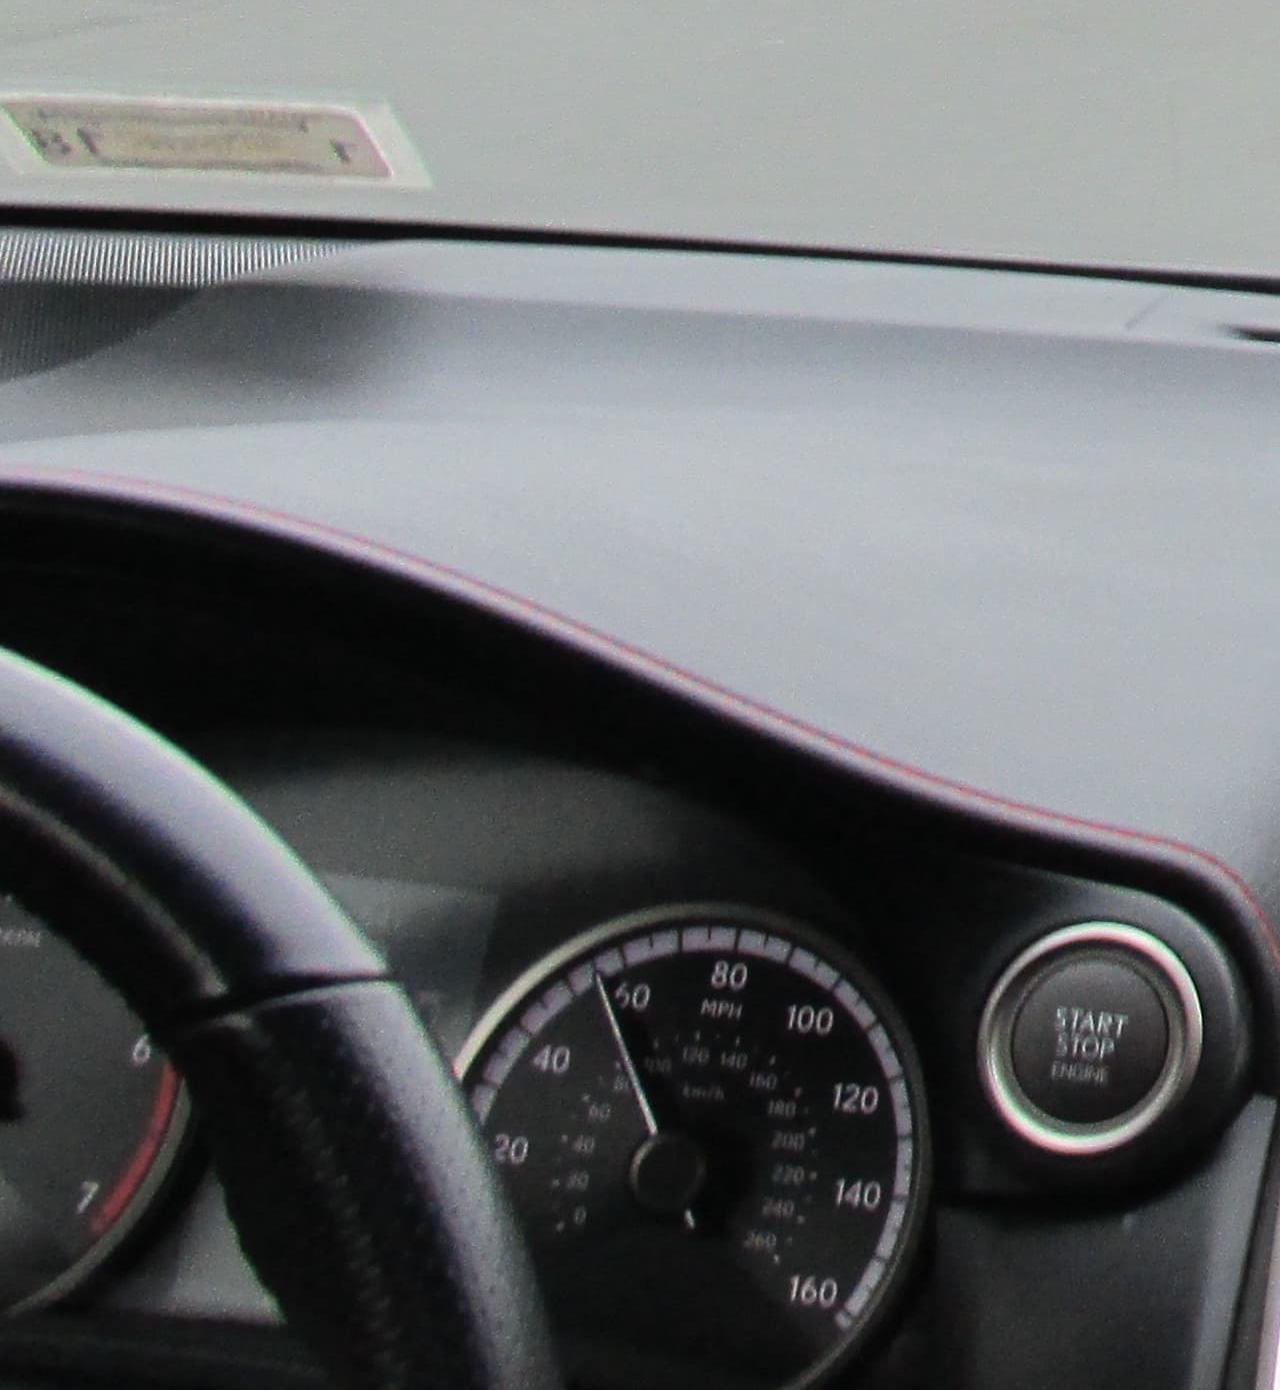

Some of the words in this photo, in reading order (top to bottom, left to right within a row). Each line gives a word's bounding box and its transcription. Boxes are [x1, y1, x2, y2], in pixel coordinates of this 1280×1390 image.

[711, 960, 748, 991] 80
[615, 981, 651, 1011] 60
[700, 997, 743, 1021] MPH
[786, 1004, 834, 1036] 100
[1055, 1005, 1129, 1039] START
[131, 1034, 151, 1067] 6
[533, 1045, 570, 1074] 40
[1055, 1032, 1116, 1060] STOP
[832, 1082, 879, 1113] 120
[494, 1132, 529, 1165] 20
[77, 1180, 99, 1213] 7
[834, 1177, 881, 1208] 140
[789, 1275, 838, 1309] 160
